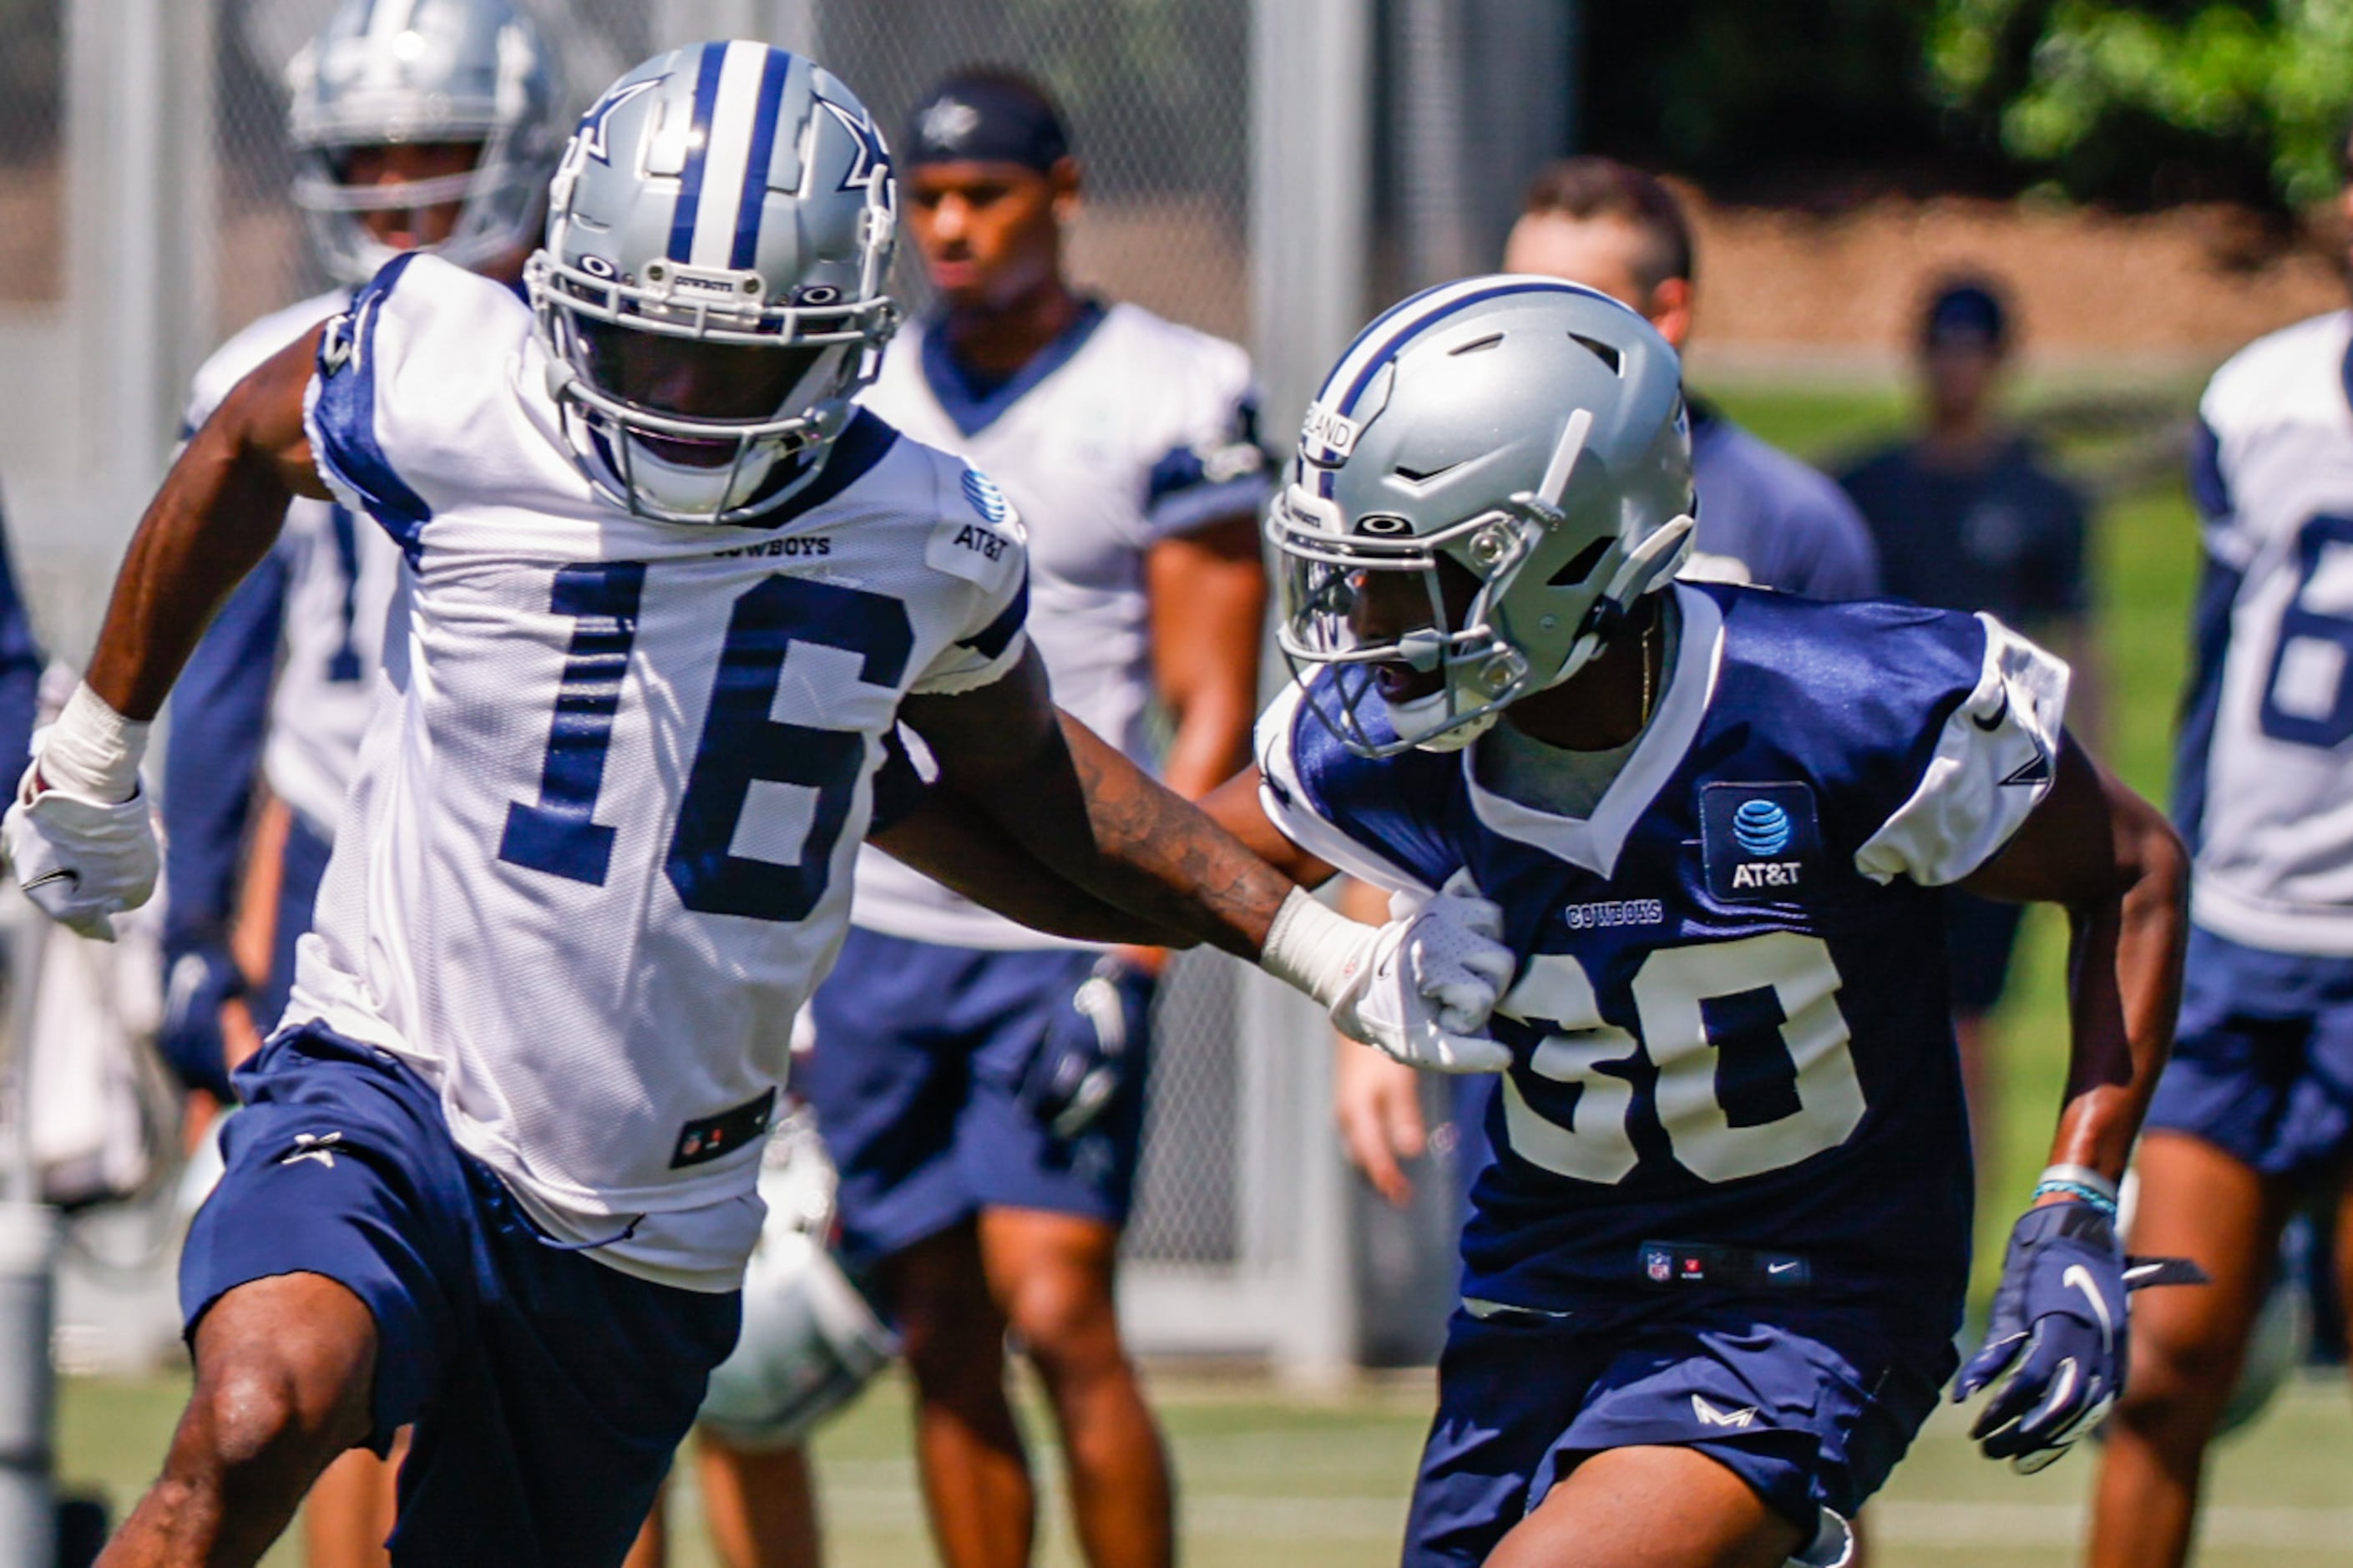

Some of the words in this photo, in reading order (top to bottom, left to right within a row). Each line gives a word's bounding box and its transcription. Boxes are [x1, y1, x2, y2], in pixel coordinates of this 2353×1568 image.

[713, 537, 831, 558] WBOYS
[953, 524, 1009, 563] AT&T
[498, 560, 915, 923] 16
[1732, 862, 1802, 889] AT&T
[1566, 898, 1664, 929] COWBOYS
[1494, 930, 1868, 1185] 30
